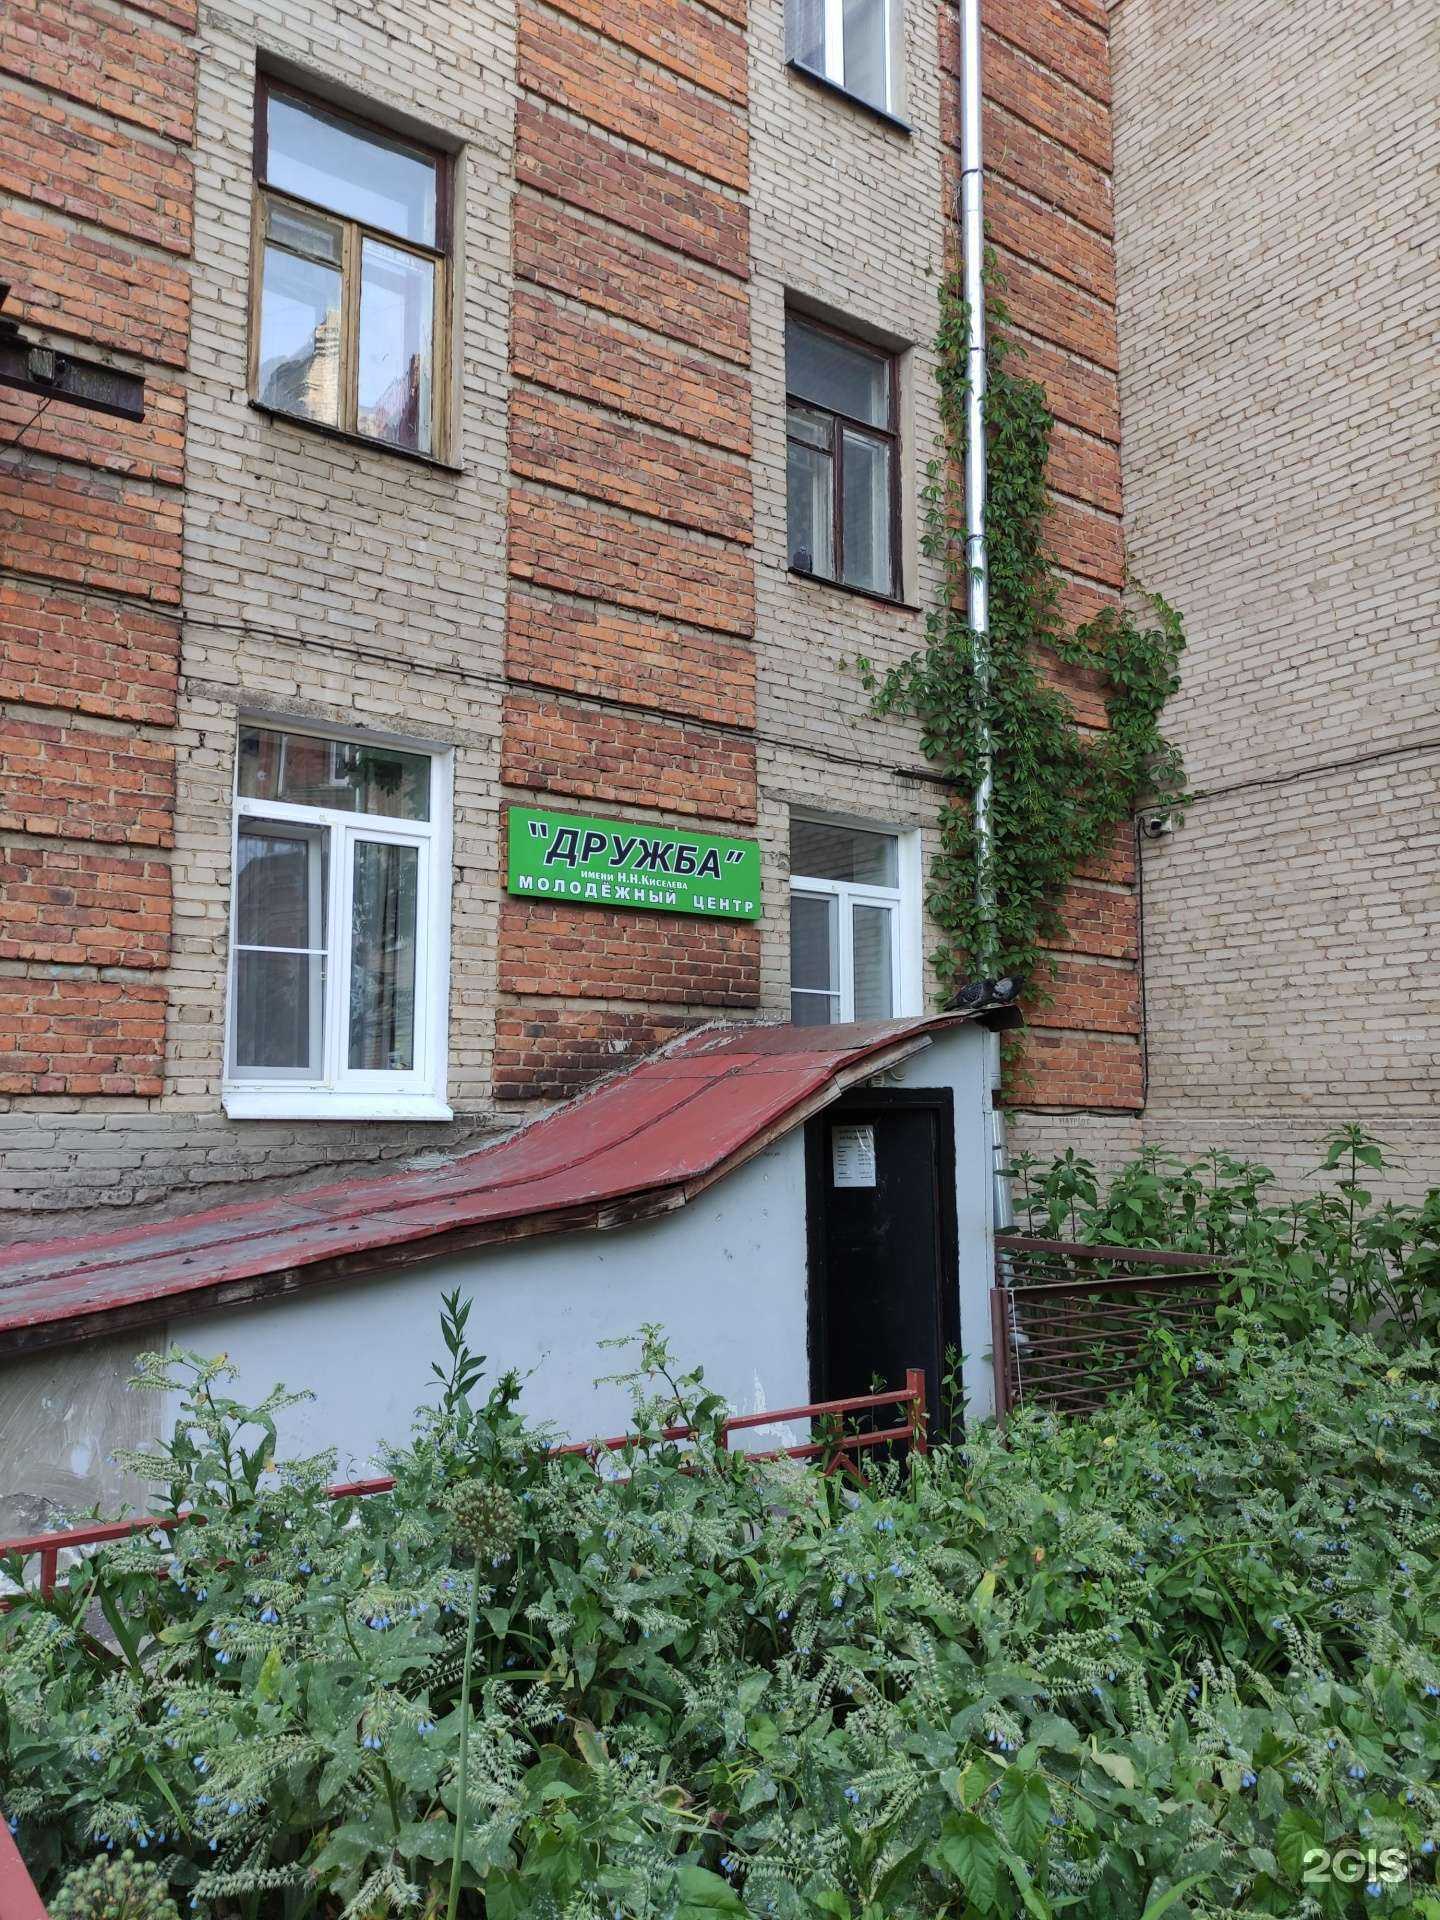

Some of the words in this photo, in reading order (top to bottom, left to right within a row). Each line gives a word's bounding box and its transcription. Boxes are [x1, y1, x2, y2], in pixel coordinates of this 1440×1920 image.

[527, 820, 746, 880] "ДРУЖБА"
[519, 875, 676, 905] МОЛОДЁЖНЫЙ
[693, 895, 754, 913] ЦЕНТР
